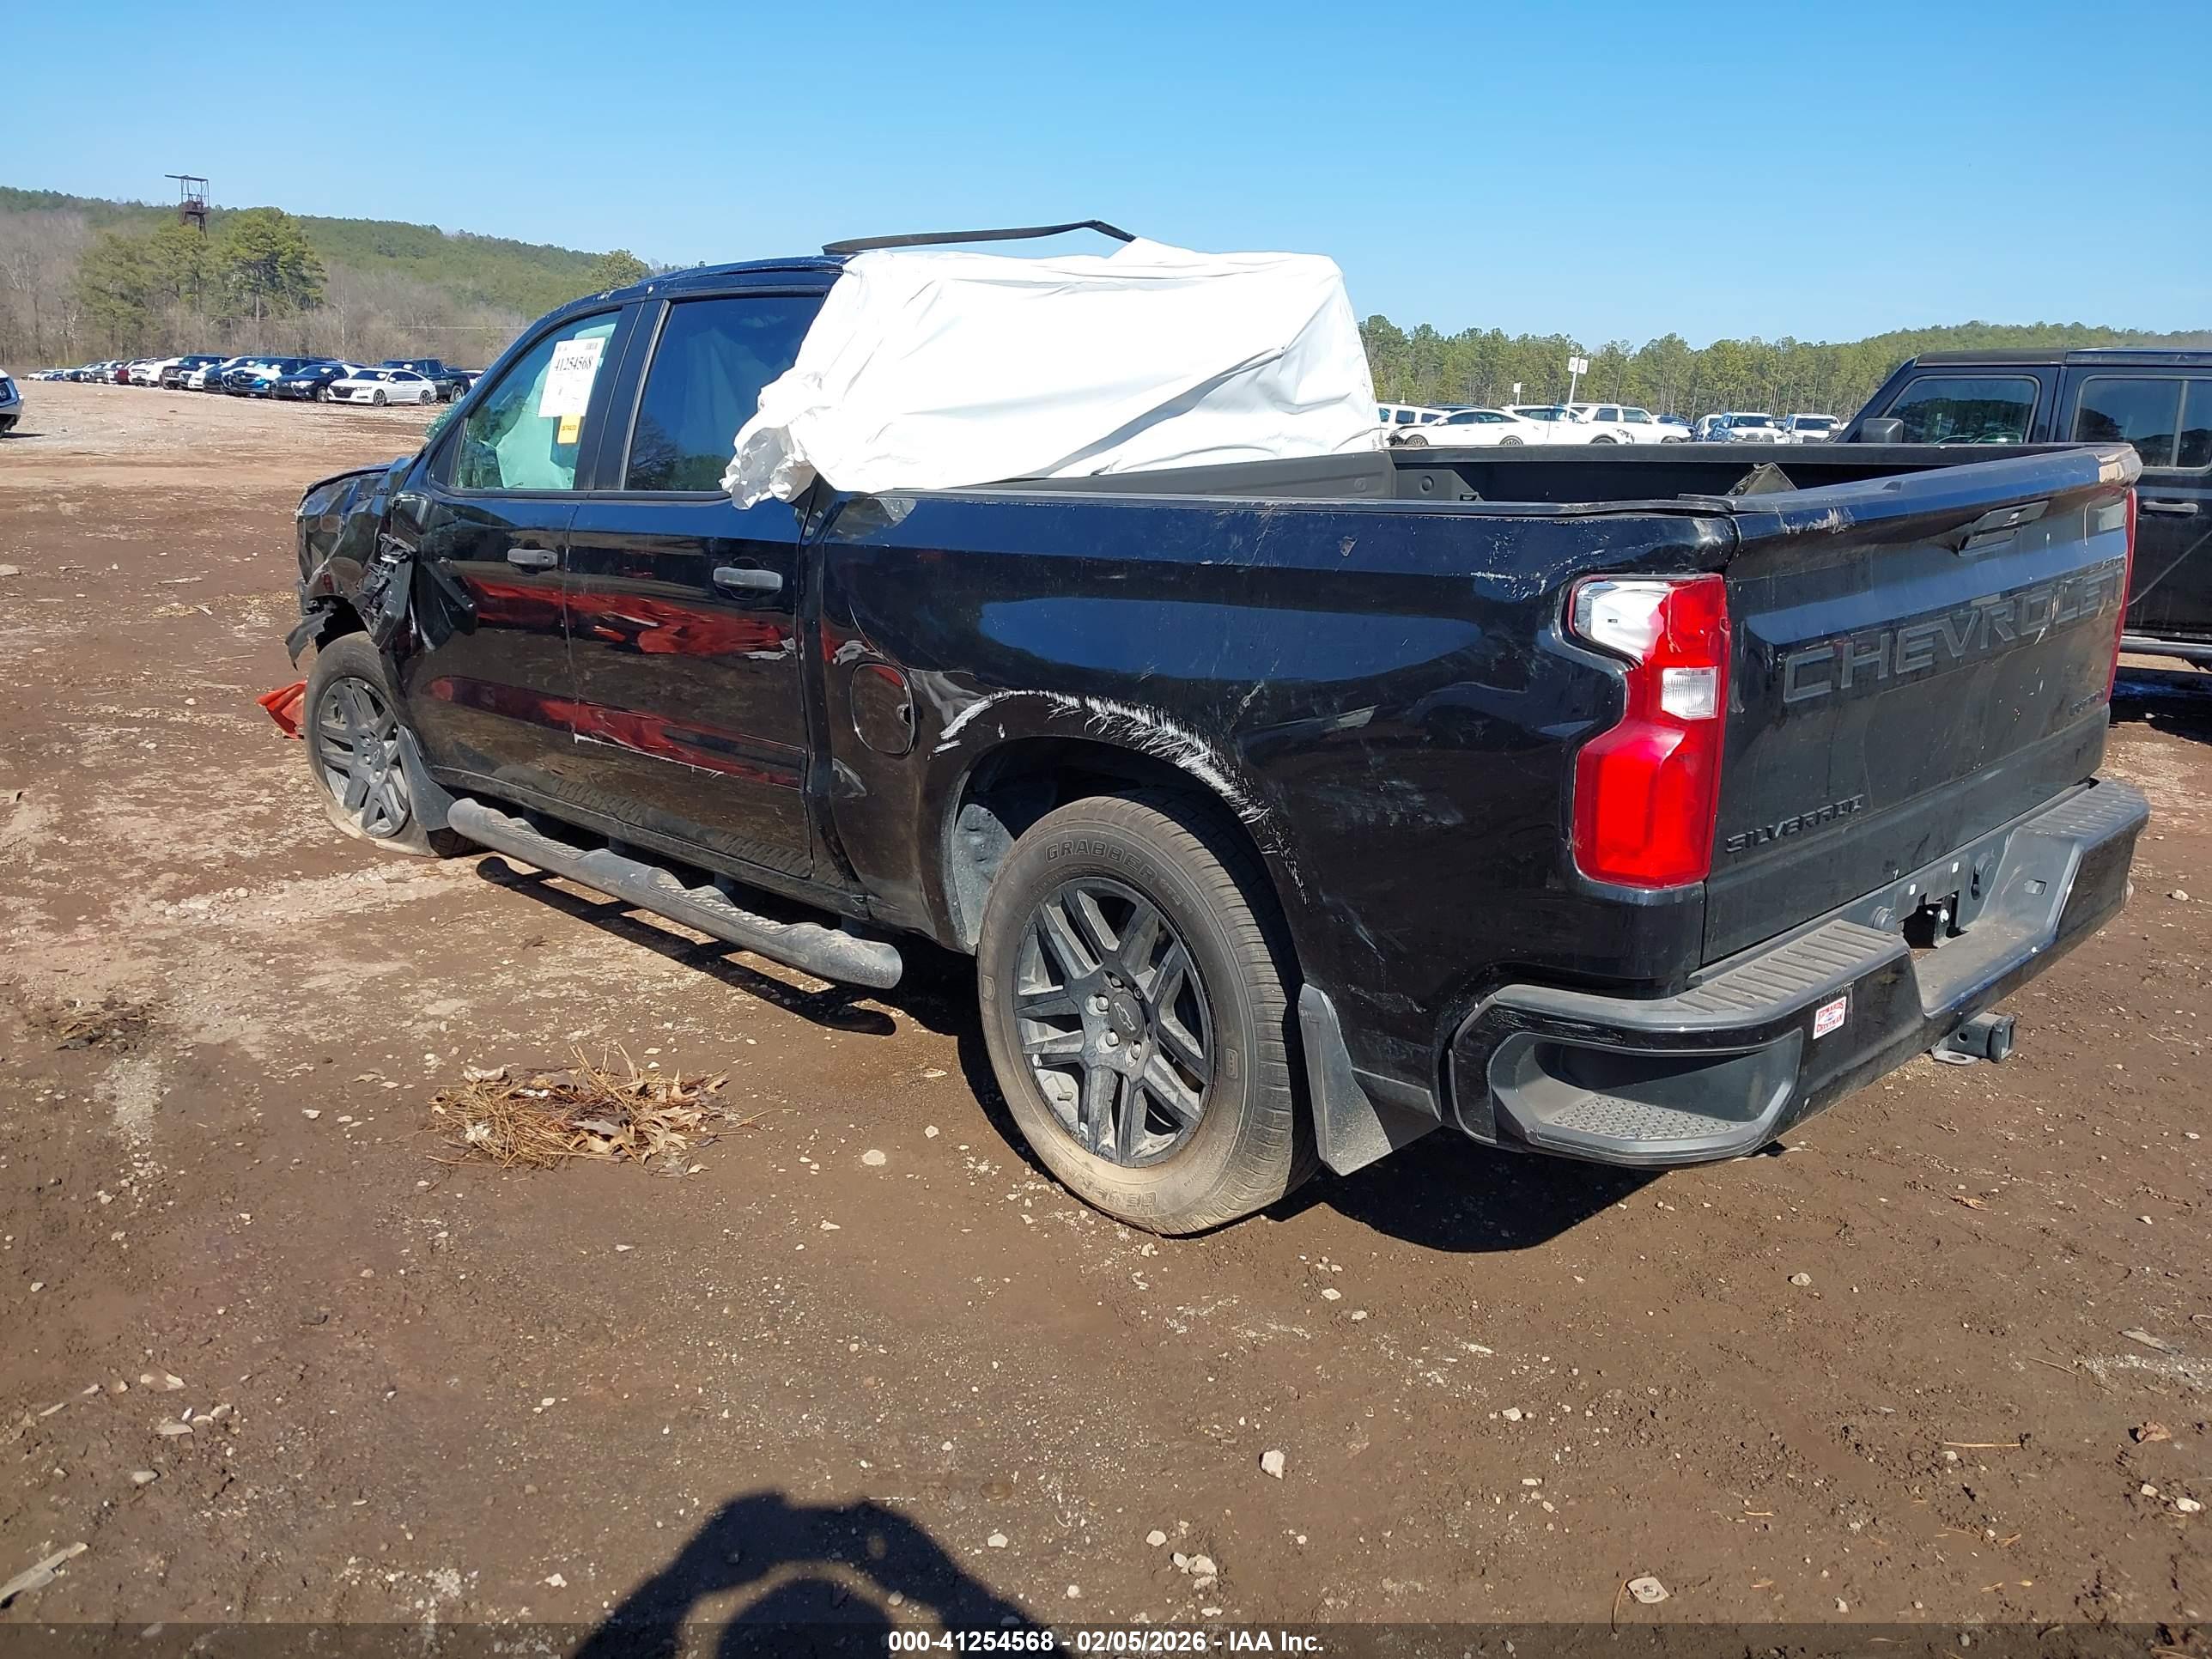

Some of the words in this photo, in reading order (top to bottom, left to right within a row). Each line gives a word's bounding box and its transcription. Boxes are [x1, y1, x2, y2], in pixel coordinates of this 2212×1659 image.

[555, 356, 593, 371] 41254568
[1783, 565, 2124, 703] CHEVROLET
[1726, 793, 1865, 853] SILVERADO
[1045, 838, 1158, 884] GRABBER
